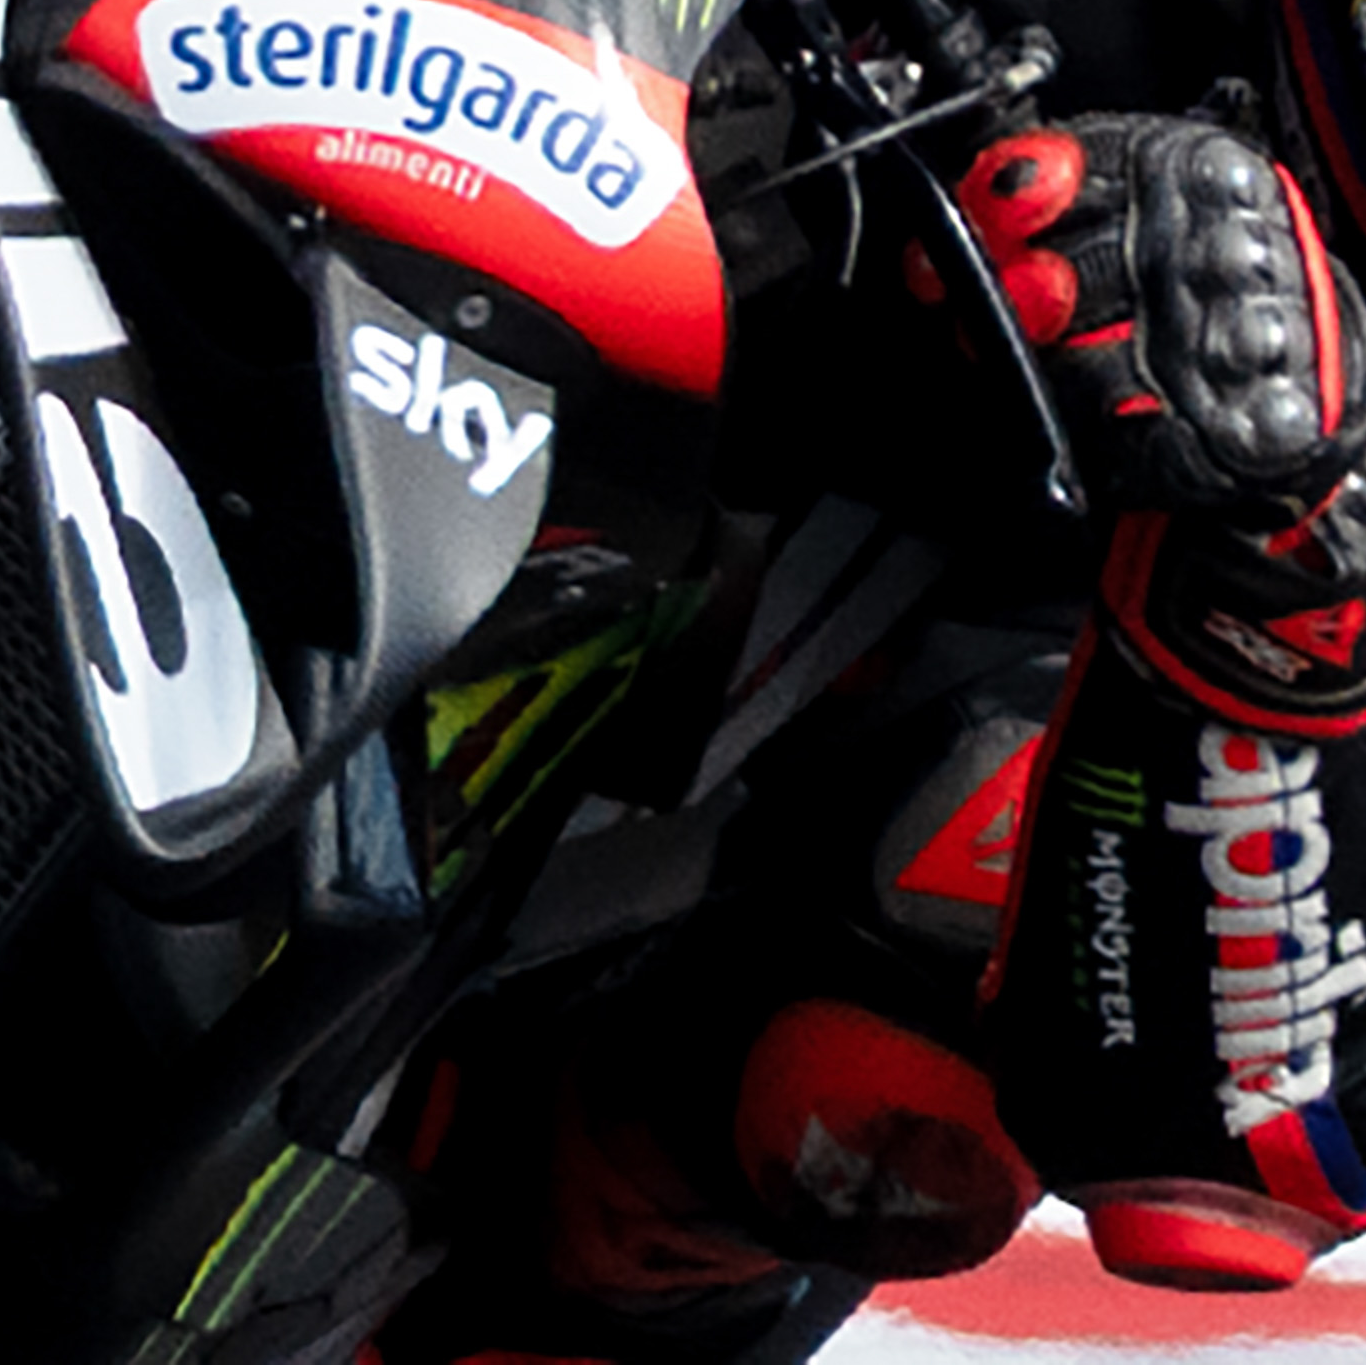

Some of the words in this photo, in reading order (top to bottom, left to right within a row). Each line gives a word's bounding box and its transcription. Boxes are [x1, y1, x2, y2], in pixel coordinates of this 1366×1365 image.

[169, 4, 645, 210] sterilgarda
[316, 129, 484, 201] alimenti
[347, 321, 555, 497] sky
